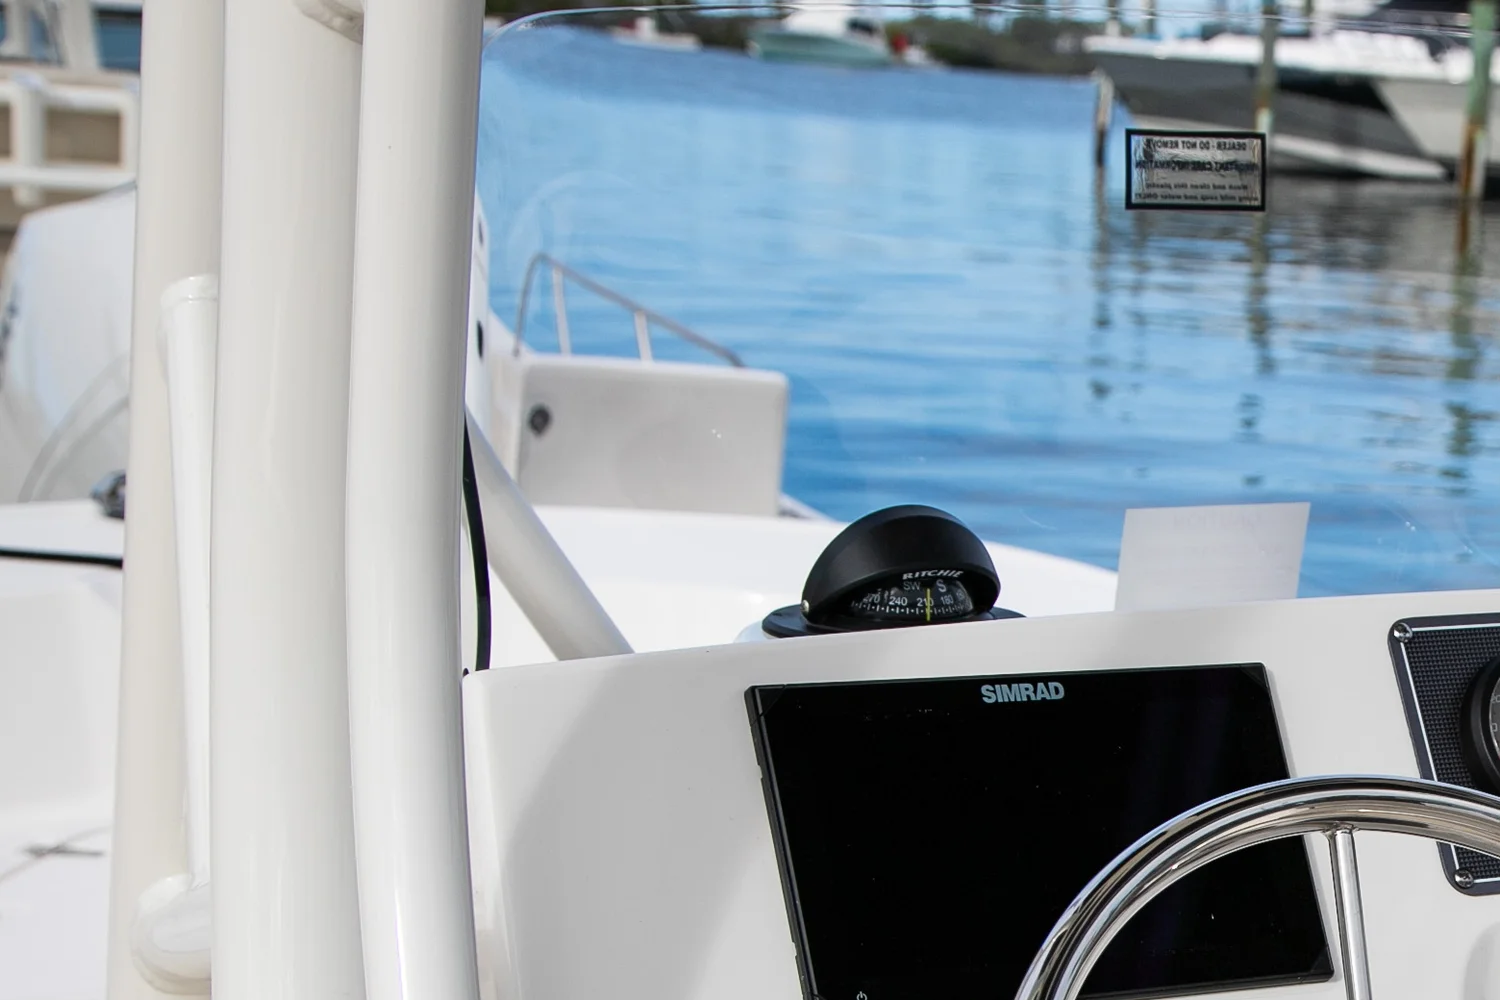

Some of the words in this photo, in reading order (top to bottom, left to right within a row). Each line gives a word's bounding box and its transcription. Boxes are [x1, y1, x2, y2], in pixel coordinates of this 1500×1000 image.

[902, 569, 964, 580] RITCHIE
[903, 581, 921, 591] SW
[936, 579, 947, 592] S
[888, 596, 908, 606] 240
[981, 682, 1065, 703] SIMRAD
